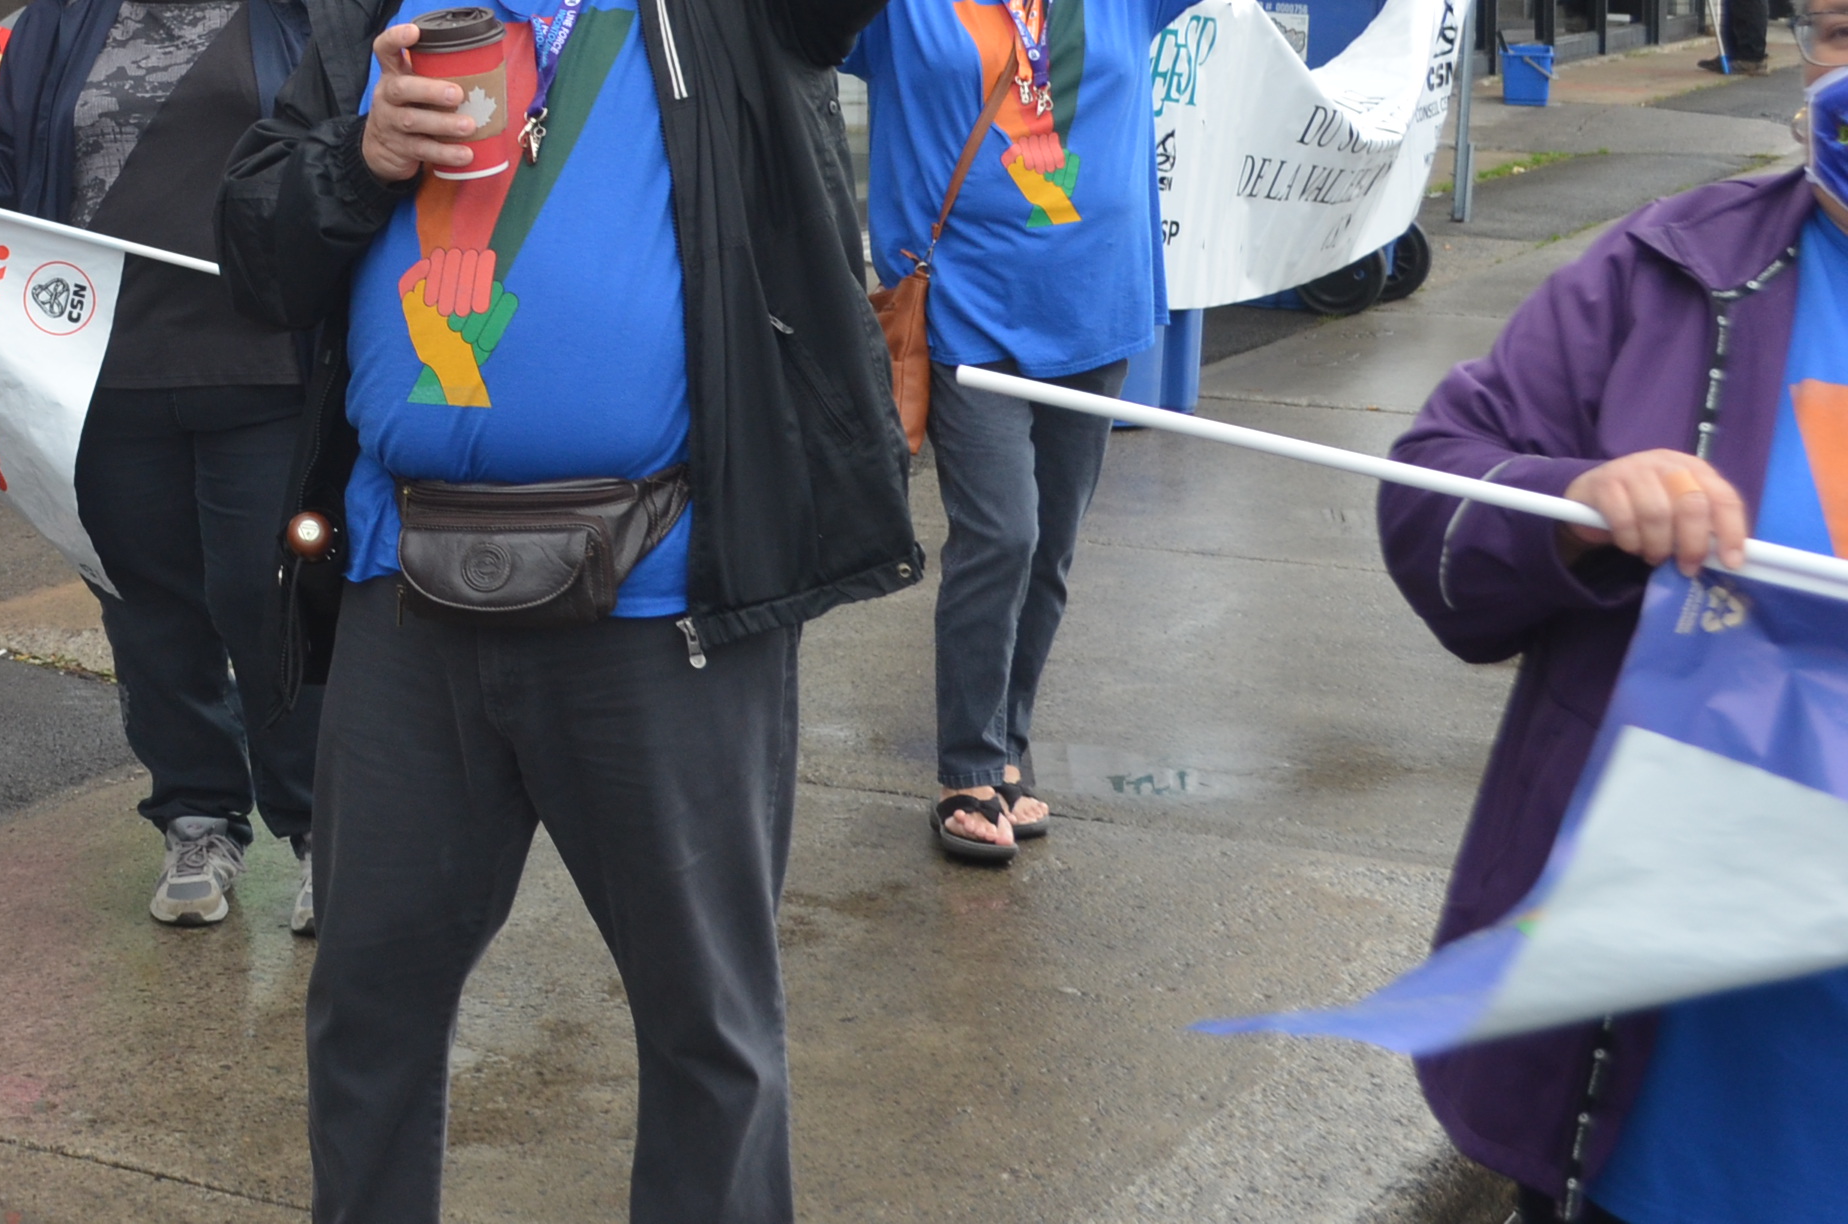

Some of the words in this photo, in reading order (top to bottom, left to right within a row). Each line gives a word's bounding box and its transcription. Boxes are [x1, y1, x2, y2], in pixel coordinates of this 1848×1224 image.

[566, 10, 577, 28] UNE
[550, 25, 570, 56] FORCE
[66, 282, 88, 324] CSN
